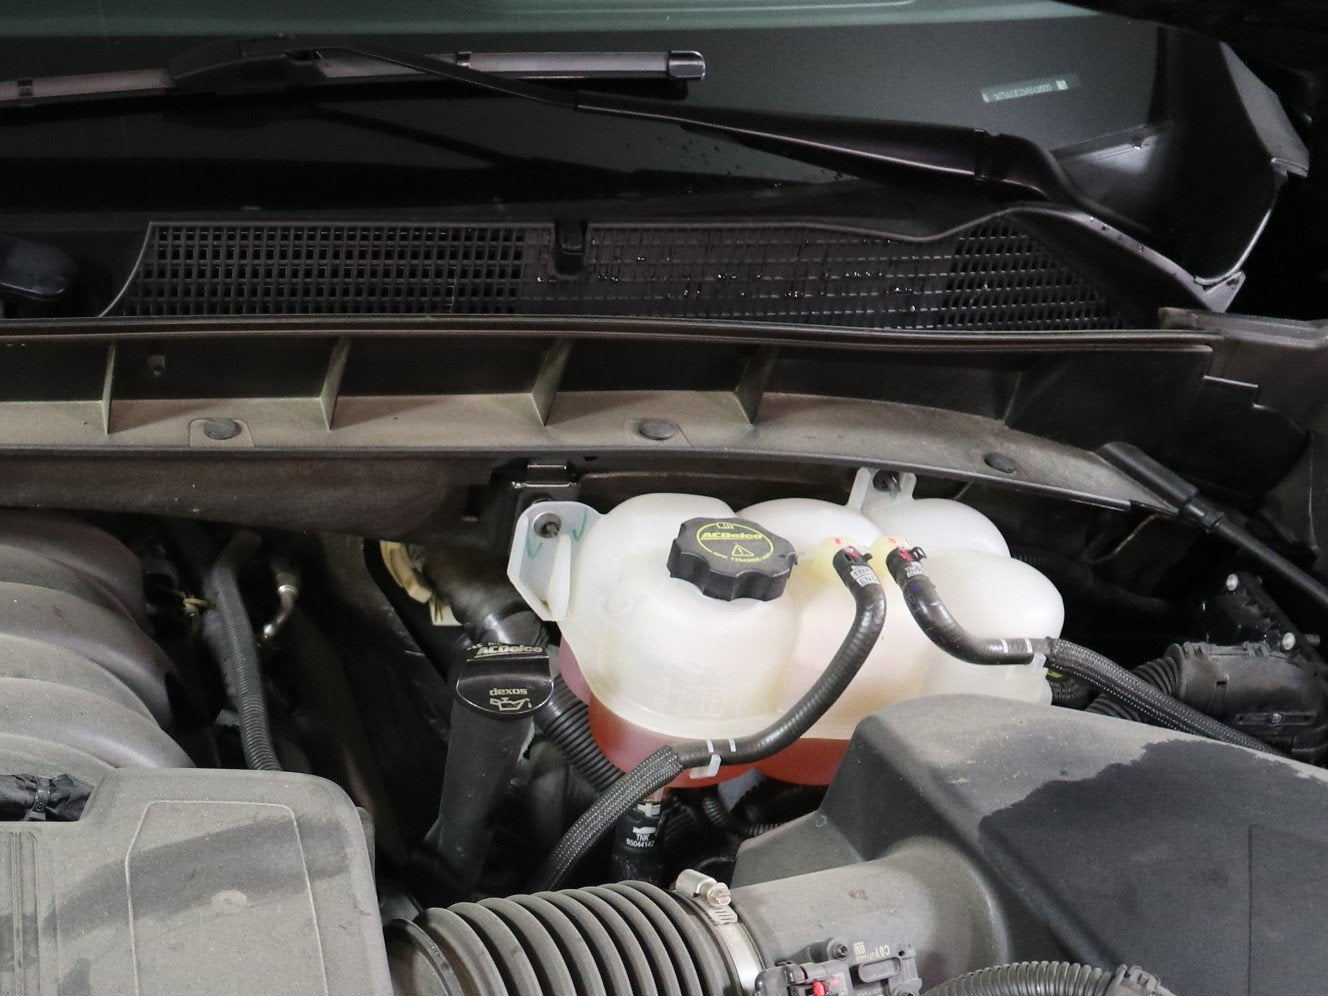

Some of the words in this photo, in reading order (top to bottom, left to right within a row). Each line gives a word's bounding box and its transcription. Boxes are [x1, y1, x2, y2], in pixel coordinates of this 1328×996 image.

[700, 531, 763, 541] ACDelco
[474, 645, 544, 658] ACDelco
[489, 687, 528, 696] dexos
